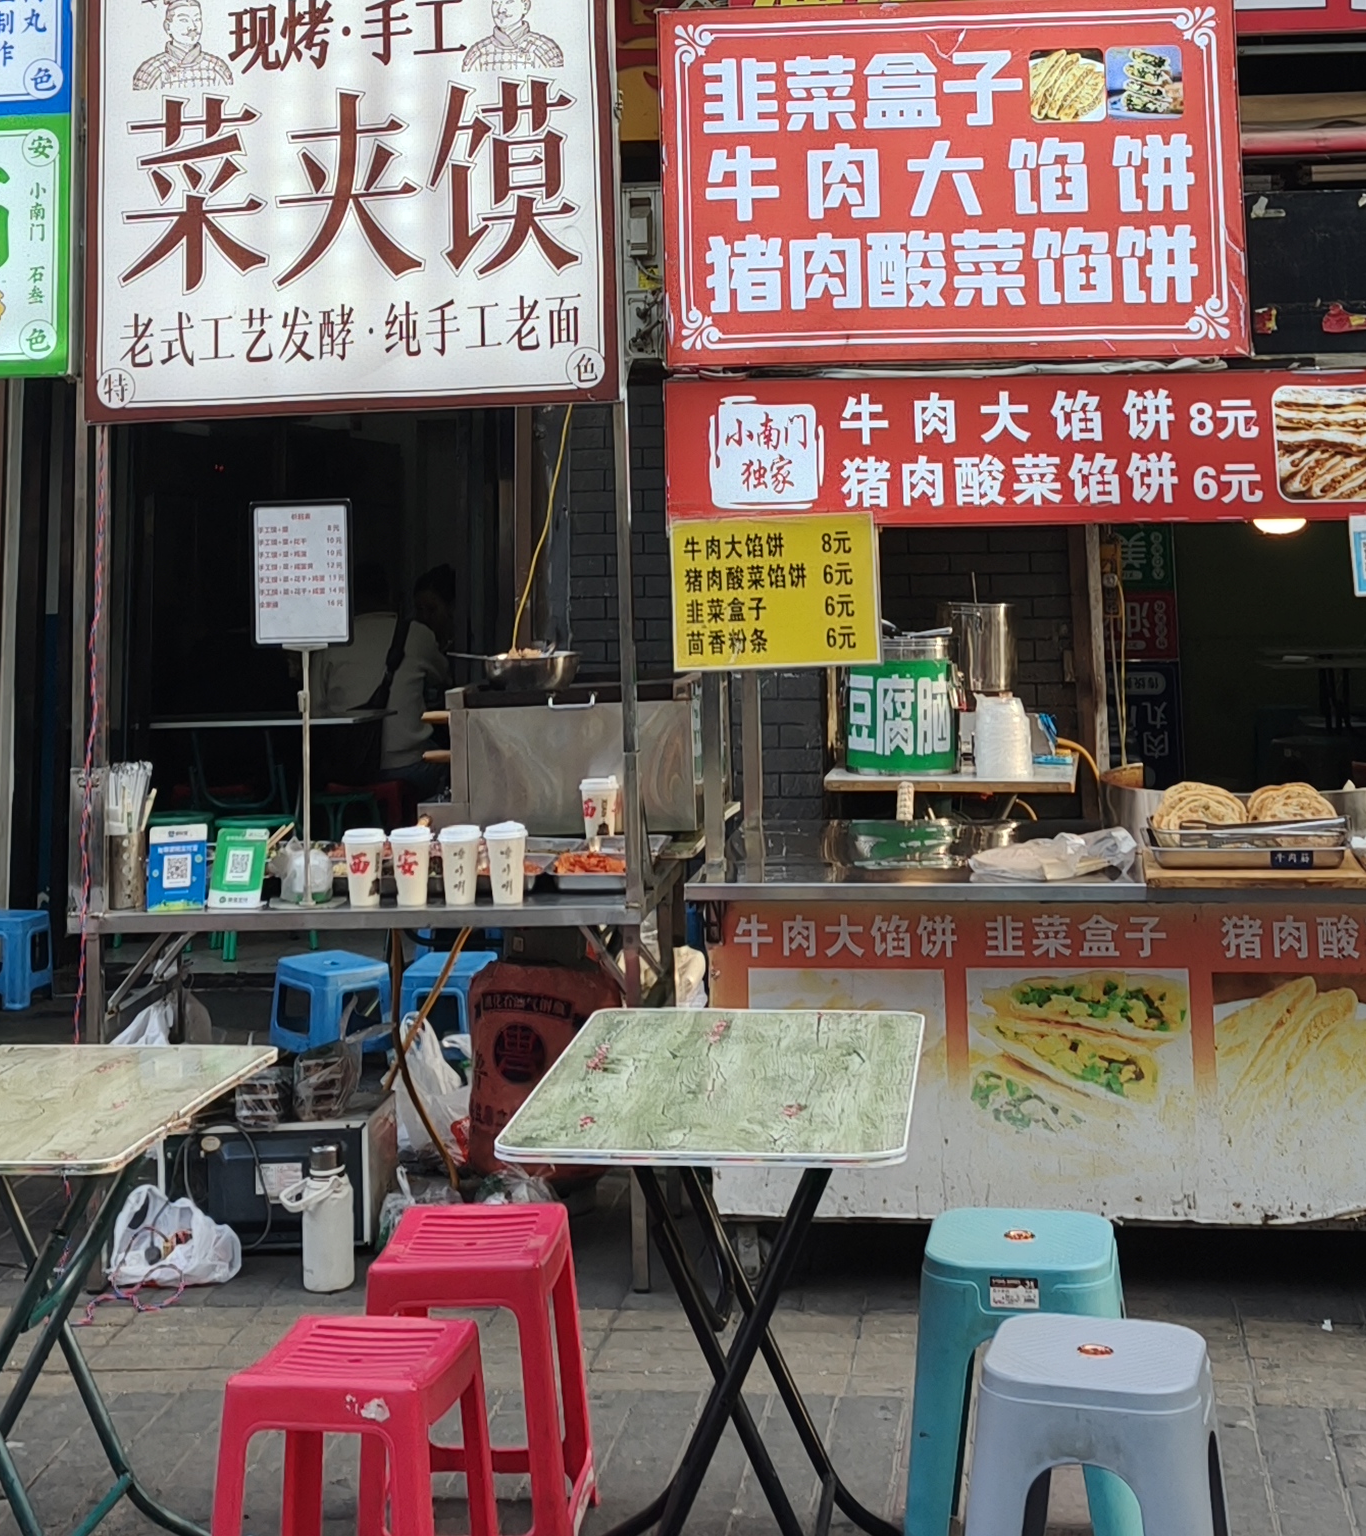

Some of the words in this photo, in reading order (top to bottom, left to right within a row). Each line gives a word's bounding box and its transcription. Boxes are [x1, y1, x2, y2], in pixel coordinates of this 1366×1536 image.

[30, 68, 57, 91] 色
[703, 49, 1022, 134] 韭菜盒子
[28, 136, 55, 159] 安
[119, 76, 582, 294] 菜夹馍
[705, 133, 1196, 221] 牛肉大馅饼
[29, 182, 46, 242] 小南门
[705, 224, 1199, 315] 猪肉酸菜馅饼
[25, 328, 51, 352] 色
[574, 355, 599, 382] 色
[103, 375, 129, 402] 特
[726, 411, 808, 450] 小南门
[840, 388, 1176, 447] 牛肉大馅饼
[1189, 398, 1261, 441] 8元
[741, 454, 795, 494] 独家
[842, 451, 1179, 510] 猪肉酸菜馅饼
[1193, 462, 1265, 505] 6元
[684, 532, 785, 561] 牛肉大馅饼
[822, 531, 852, 554] 8元
[685, 563, 807, 593] 猪肉酸菜馅饼
[823, 562, 853, 585] 6元
[686, 597, 767, 624] 韭菜盒子
[825, 594, 855, 617] 6元
[686, 628, 768, 656] 茴香粉条
[826, 626, 857, 649] 6元
[845, 673, 953, 756] 豆腐脑
[349, 852, 370, 875] 西
[396, 849, 419, 876] 安
[732, 914, 960, 959] 牛肉大馅饼
[985, 914, 1167, 959] 韭菜盒子
